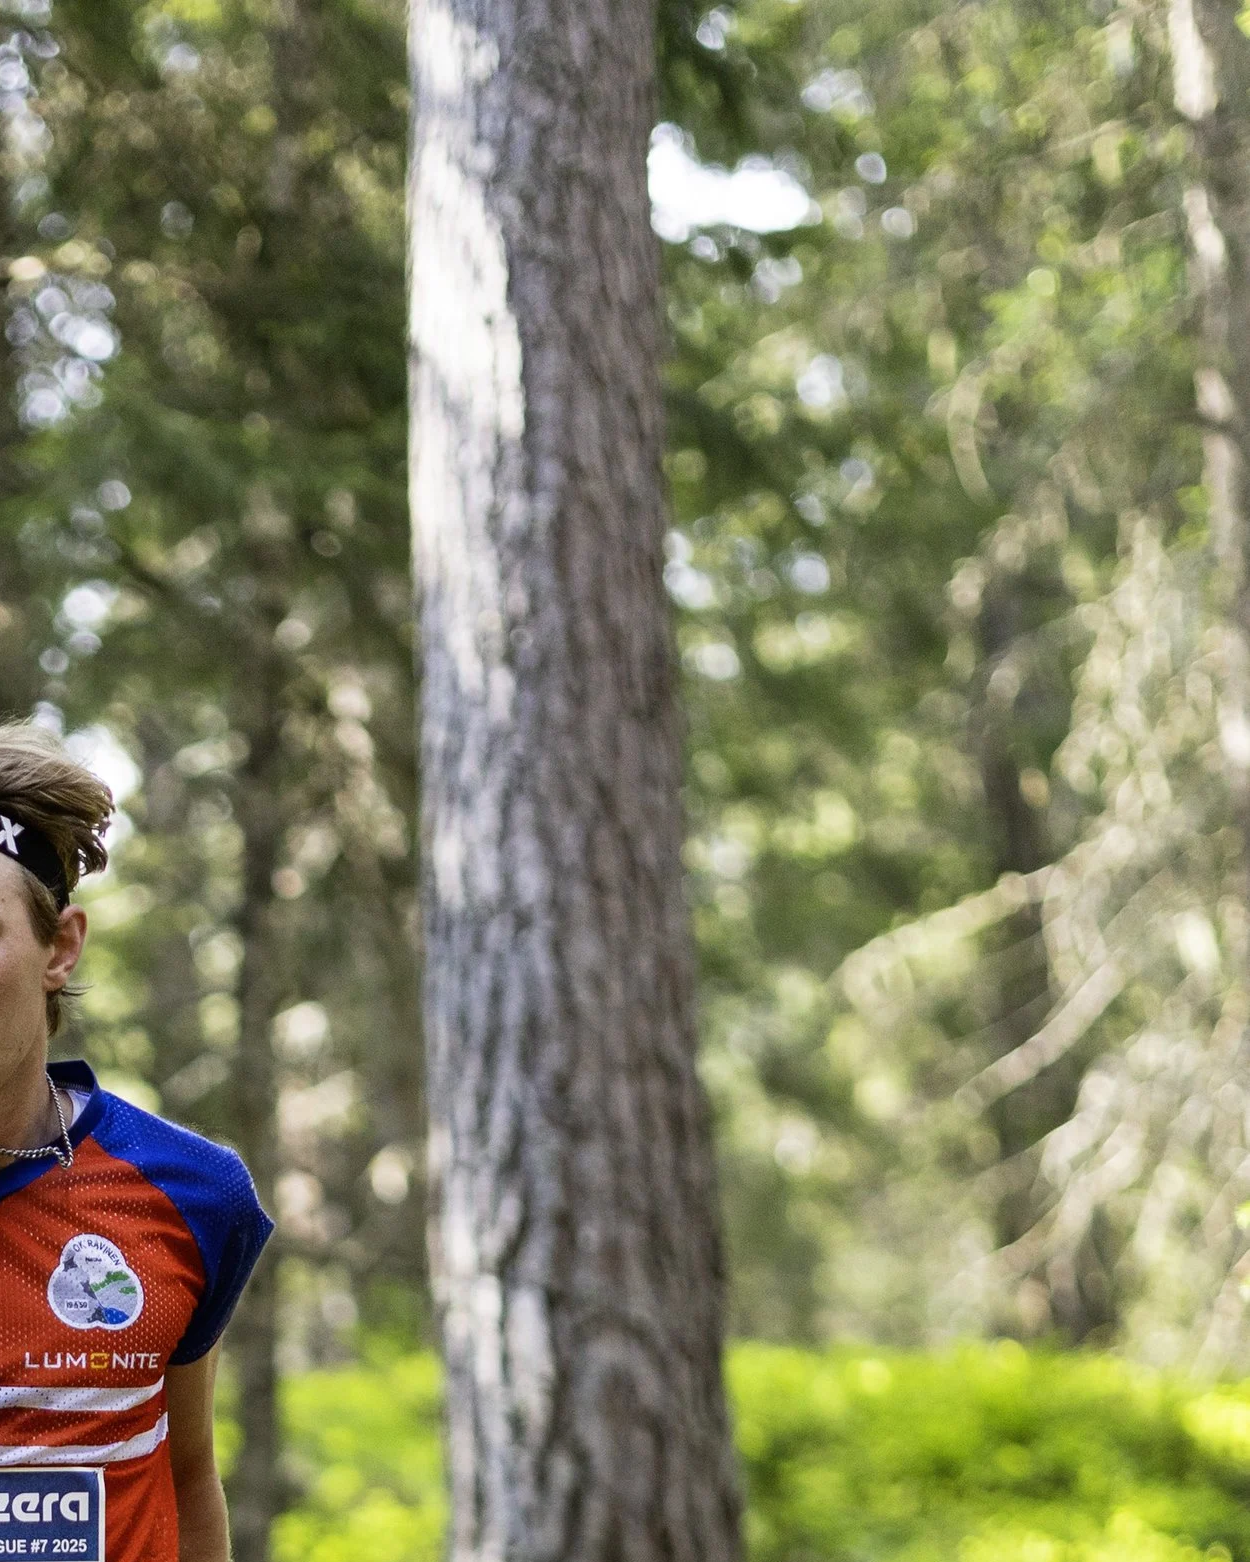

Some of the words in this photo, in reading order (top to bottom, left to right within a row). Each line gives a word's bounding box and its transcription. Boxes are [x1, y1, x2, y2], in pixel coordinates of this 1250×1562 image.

[72, 1241, 86, 1252] OK
[87, 1240, 121, 1266] RAVINEN
[25, 1352, 161, 1369] LUMONITE
[30, 1539, 48, 1553] #7
[52, 1538, 88, 1553] 2025
